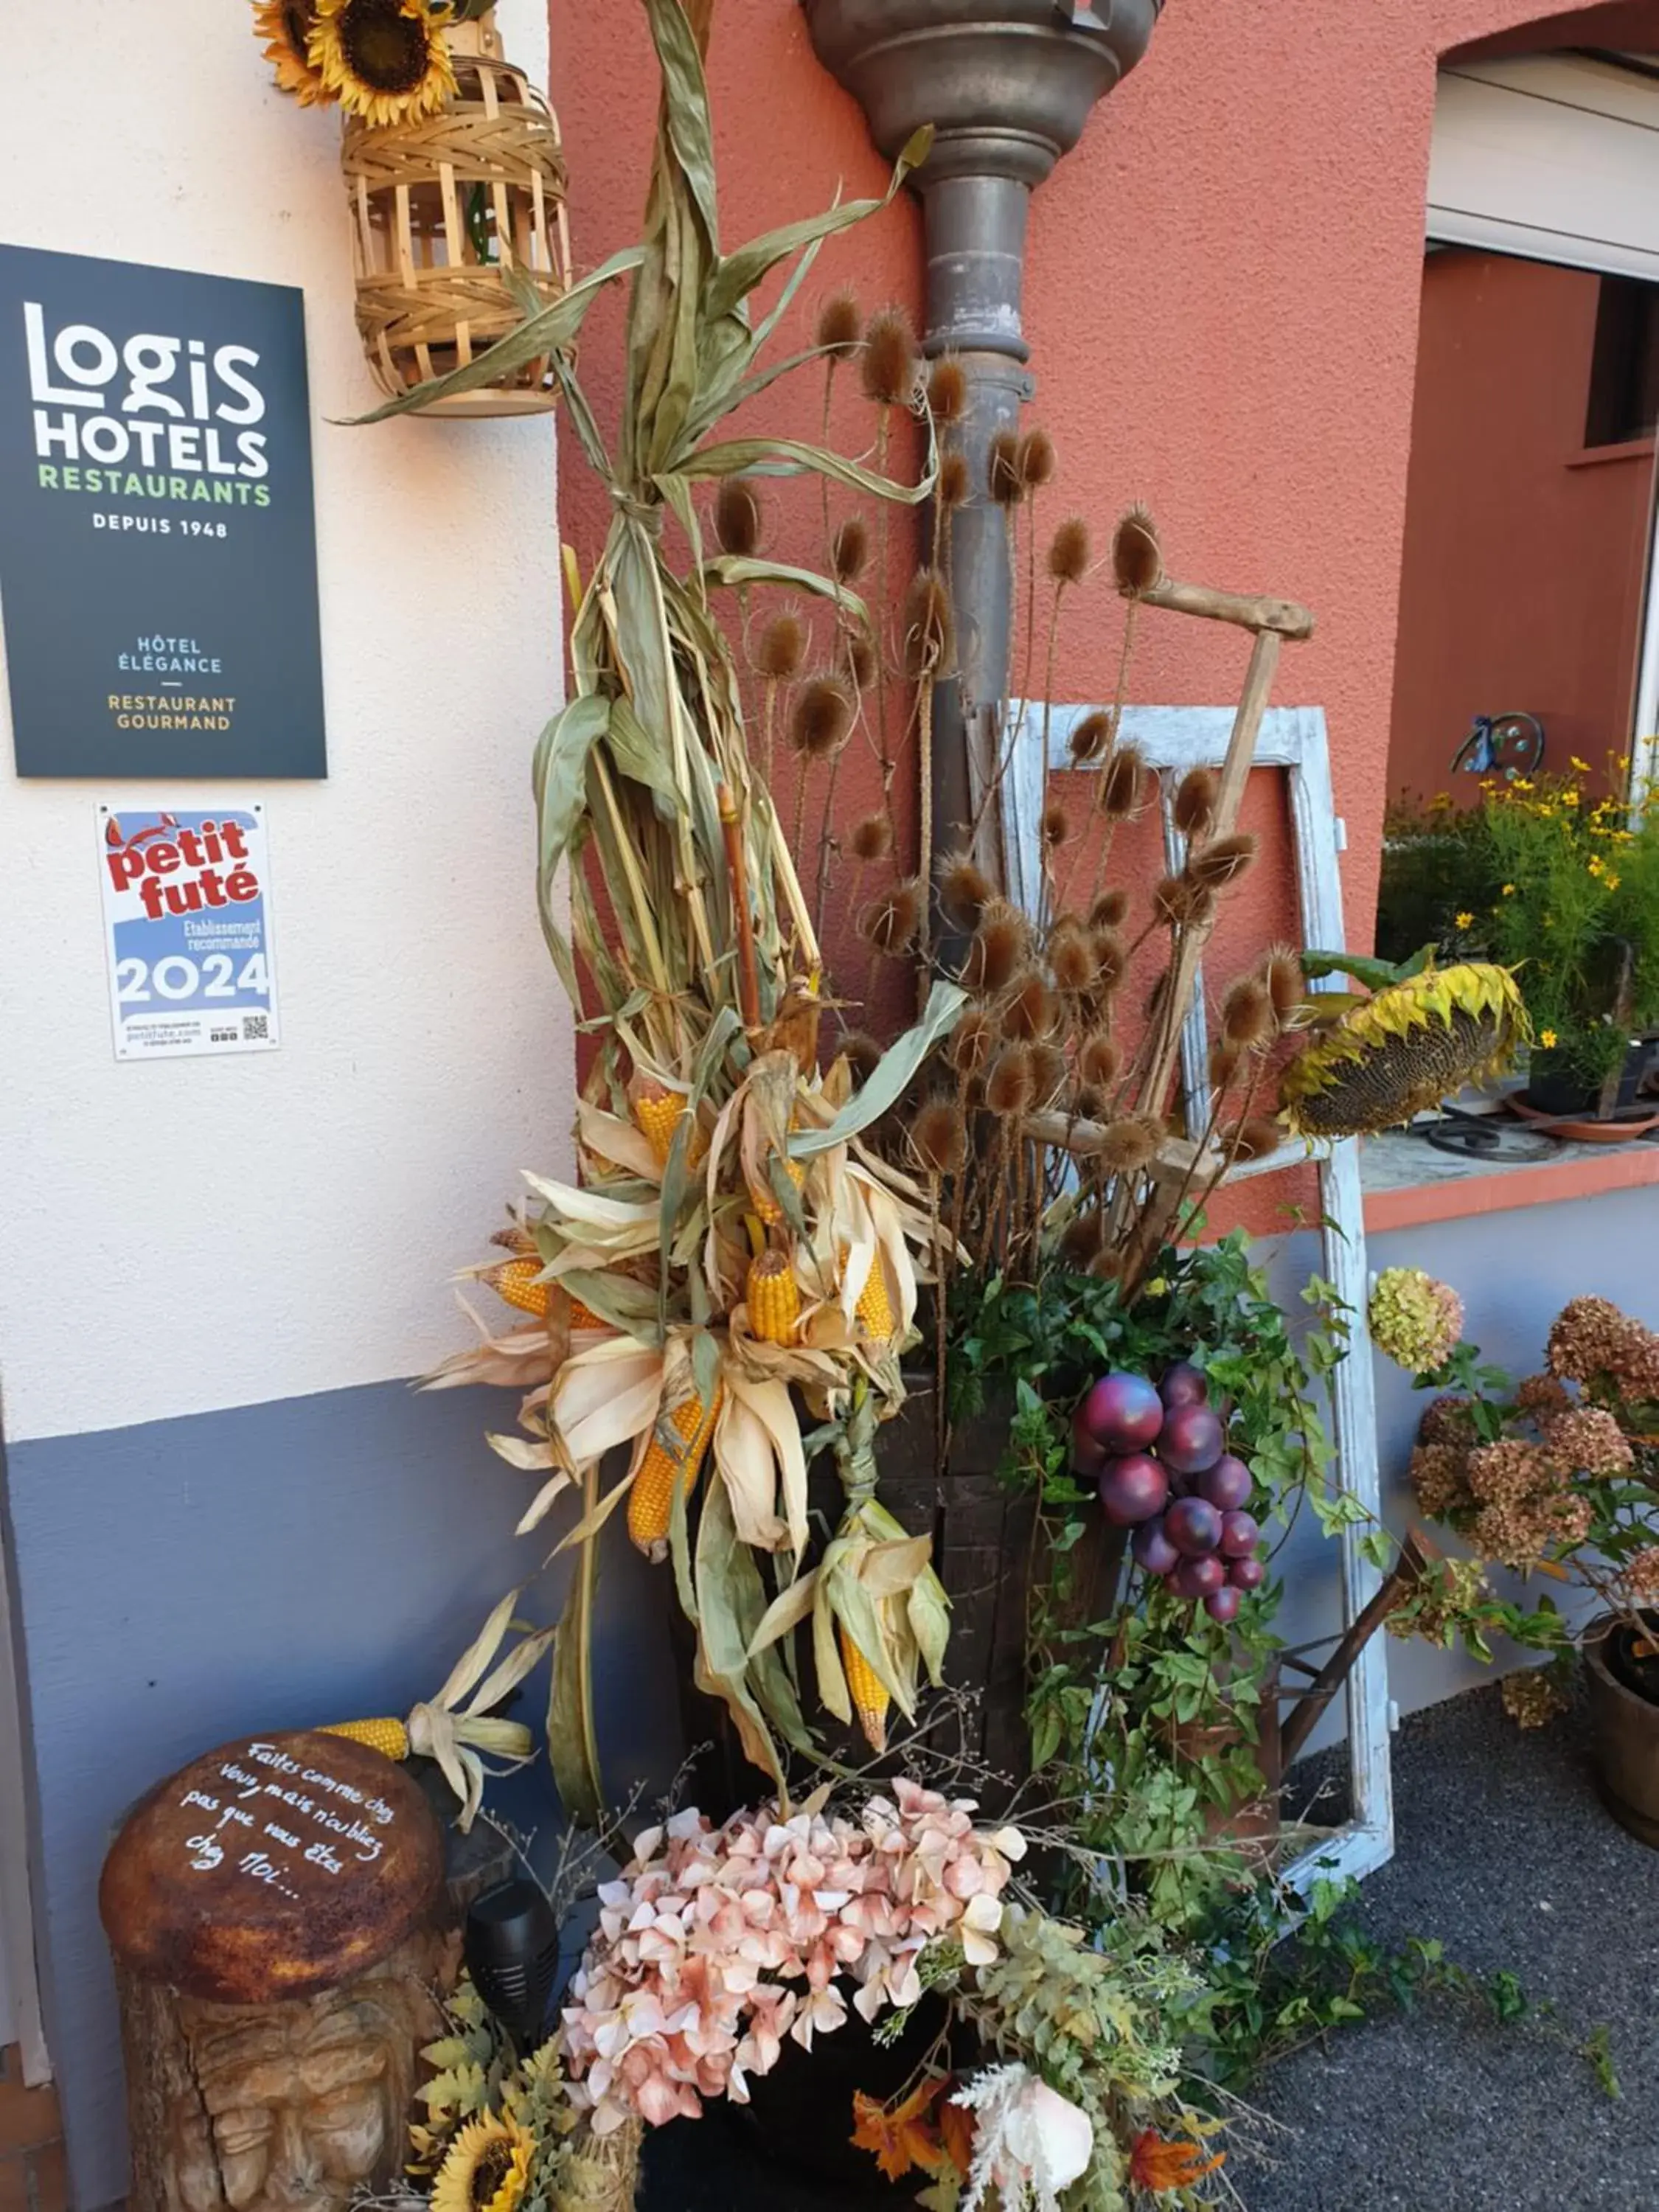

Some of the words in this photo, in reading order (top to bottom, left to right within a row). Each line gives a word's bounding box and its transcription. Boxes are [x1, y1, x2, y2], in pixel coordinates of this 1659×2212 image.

[33, 409, 269, 479] HOTELS
[38, 464, 271, 507] RESTAURANTS
[93, 512, 171, 534] DEPUIS
[180, 520, 227, 538] 1948
[118, 653, 222, 673] ÉLÉGANCE
[137, 634, 201, 654] HÔTEL
[108, 695, 236, 712] RESTAURANT
[116, 714, 231, 731] GOURMAND
[106, 821, 248, 892] petit
[139, 862, 259, 920] futé
[116, 953, 270, 1002] 2024
[248, 1743, 300, 1773] Faites
[301, 1770, 364, 1804] comme
[180, 1791, 220, 1811] pas
[215, 1806, 255, 1829] que
[263, 1822, 301, 1848] vous
[264, 1784, 315, 1813] mais
[313, 1811, 383, 1861] n'oubliez
